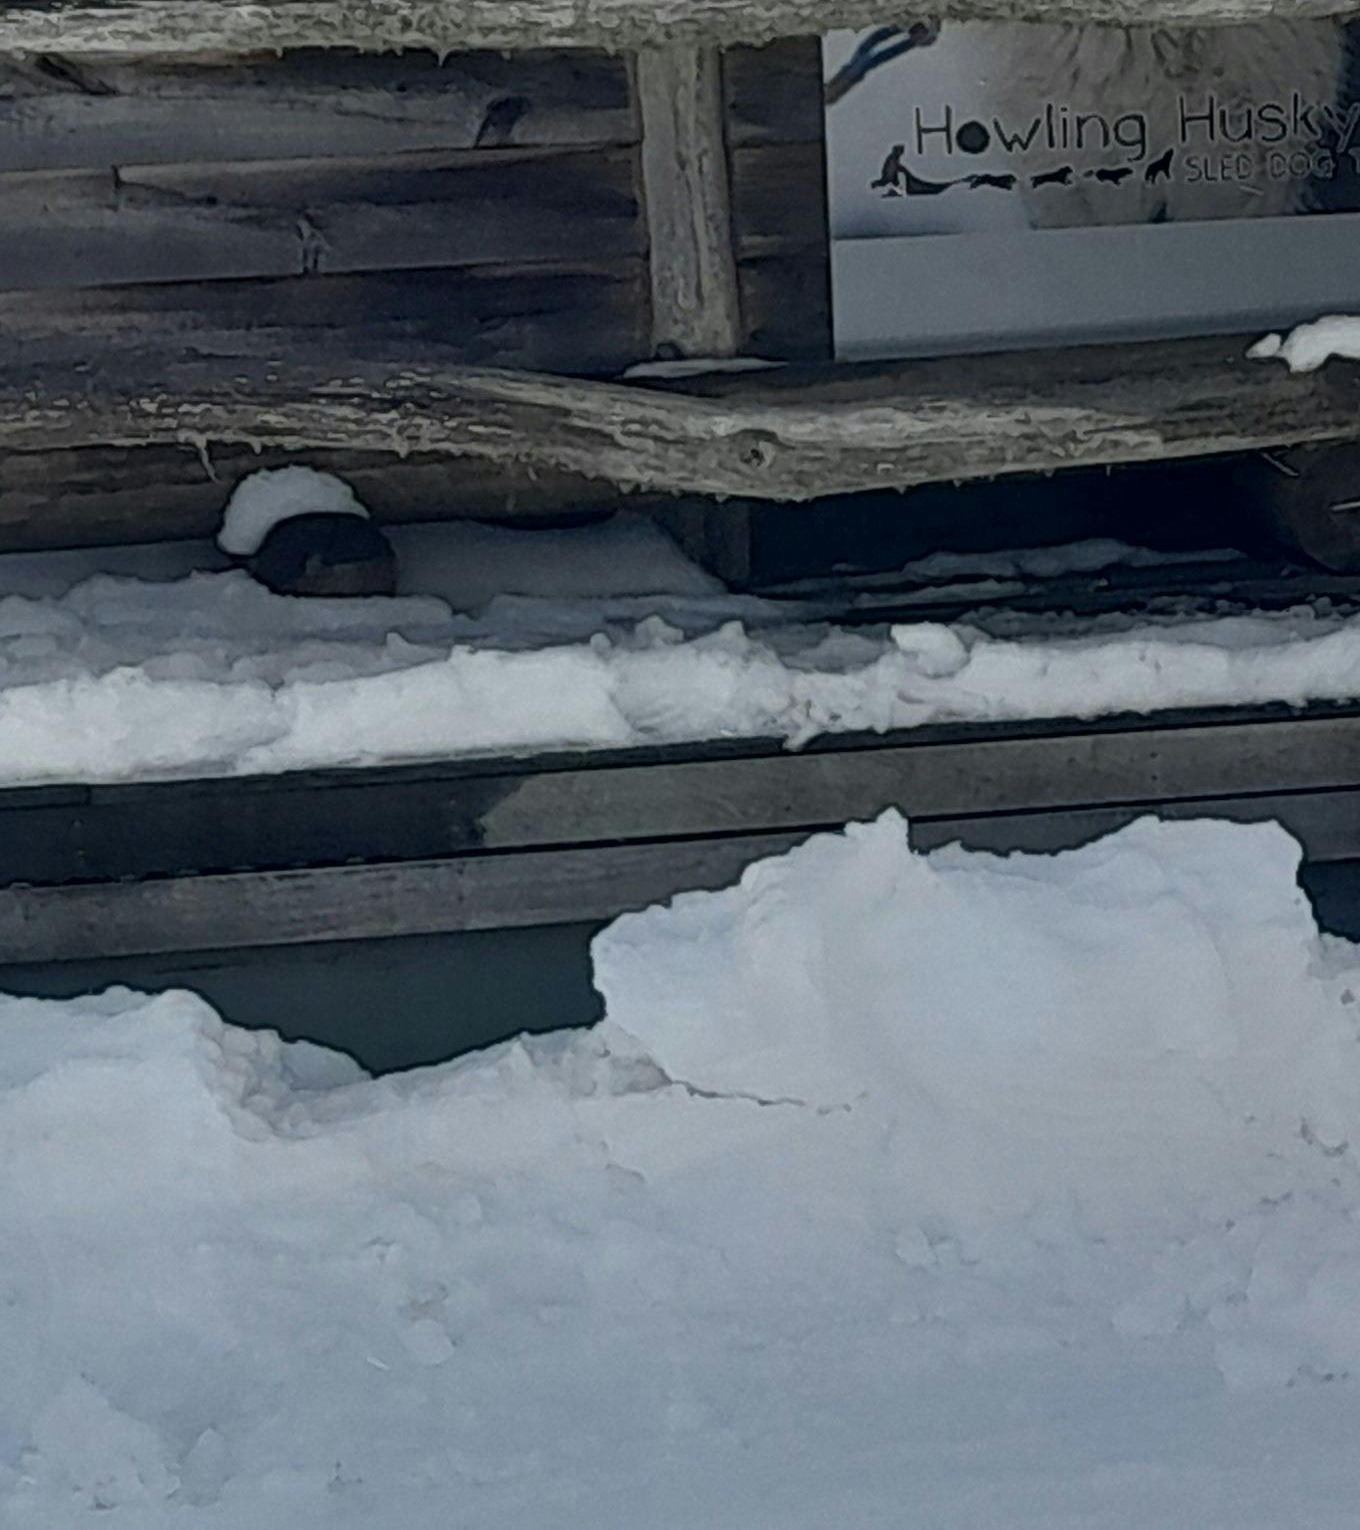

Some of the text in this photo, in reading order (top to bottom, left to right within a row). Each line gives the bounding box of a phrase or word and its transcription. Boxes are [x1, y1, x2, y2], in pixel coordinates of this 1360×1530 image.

[914, 102, 1147, 162] Howling
[1185, 153, 1253, 183] SLED
[1267, 148, 1336, 181] DOG
